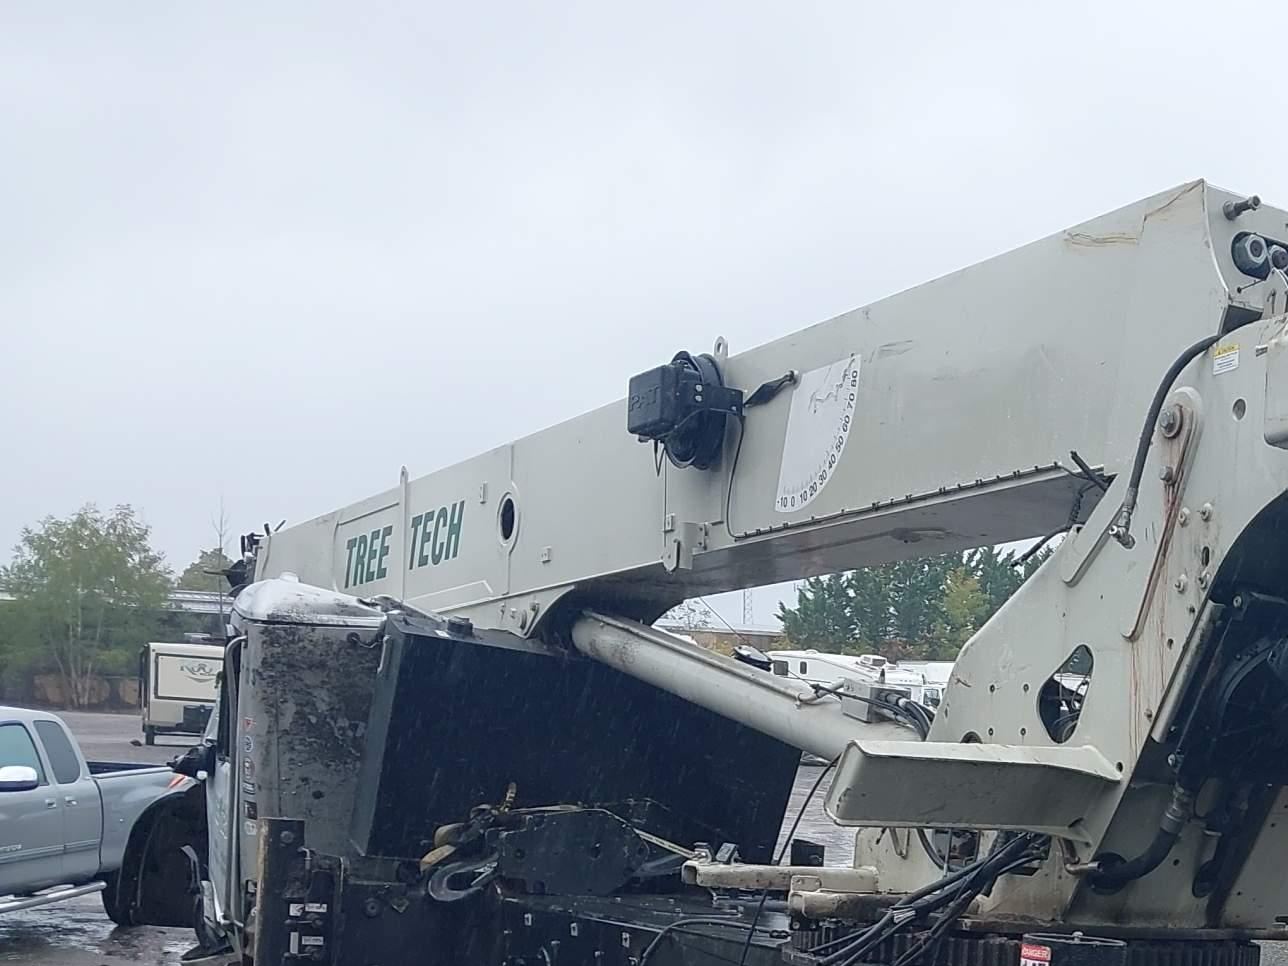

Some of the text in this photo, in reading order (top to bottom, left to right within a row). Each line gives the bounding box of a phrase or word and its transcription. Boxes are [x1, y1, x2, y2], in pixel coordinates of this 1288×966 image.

[850, 370, 858, 388] 80
[846, 393, 855, 409] 70
[842, 415, 851, 433] 60
[835, 435, 844, 453] 50
[827, 453, 837, 470] 40
[818, 469, 827, 486] 30
[799, 490, 808, 504] 10
[808, 481, 818, 497] 20
[790, 496, 796, 508] 0
[344, 500, 465, 589] TREE TECH
